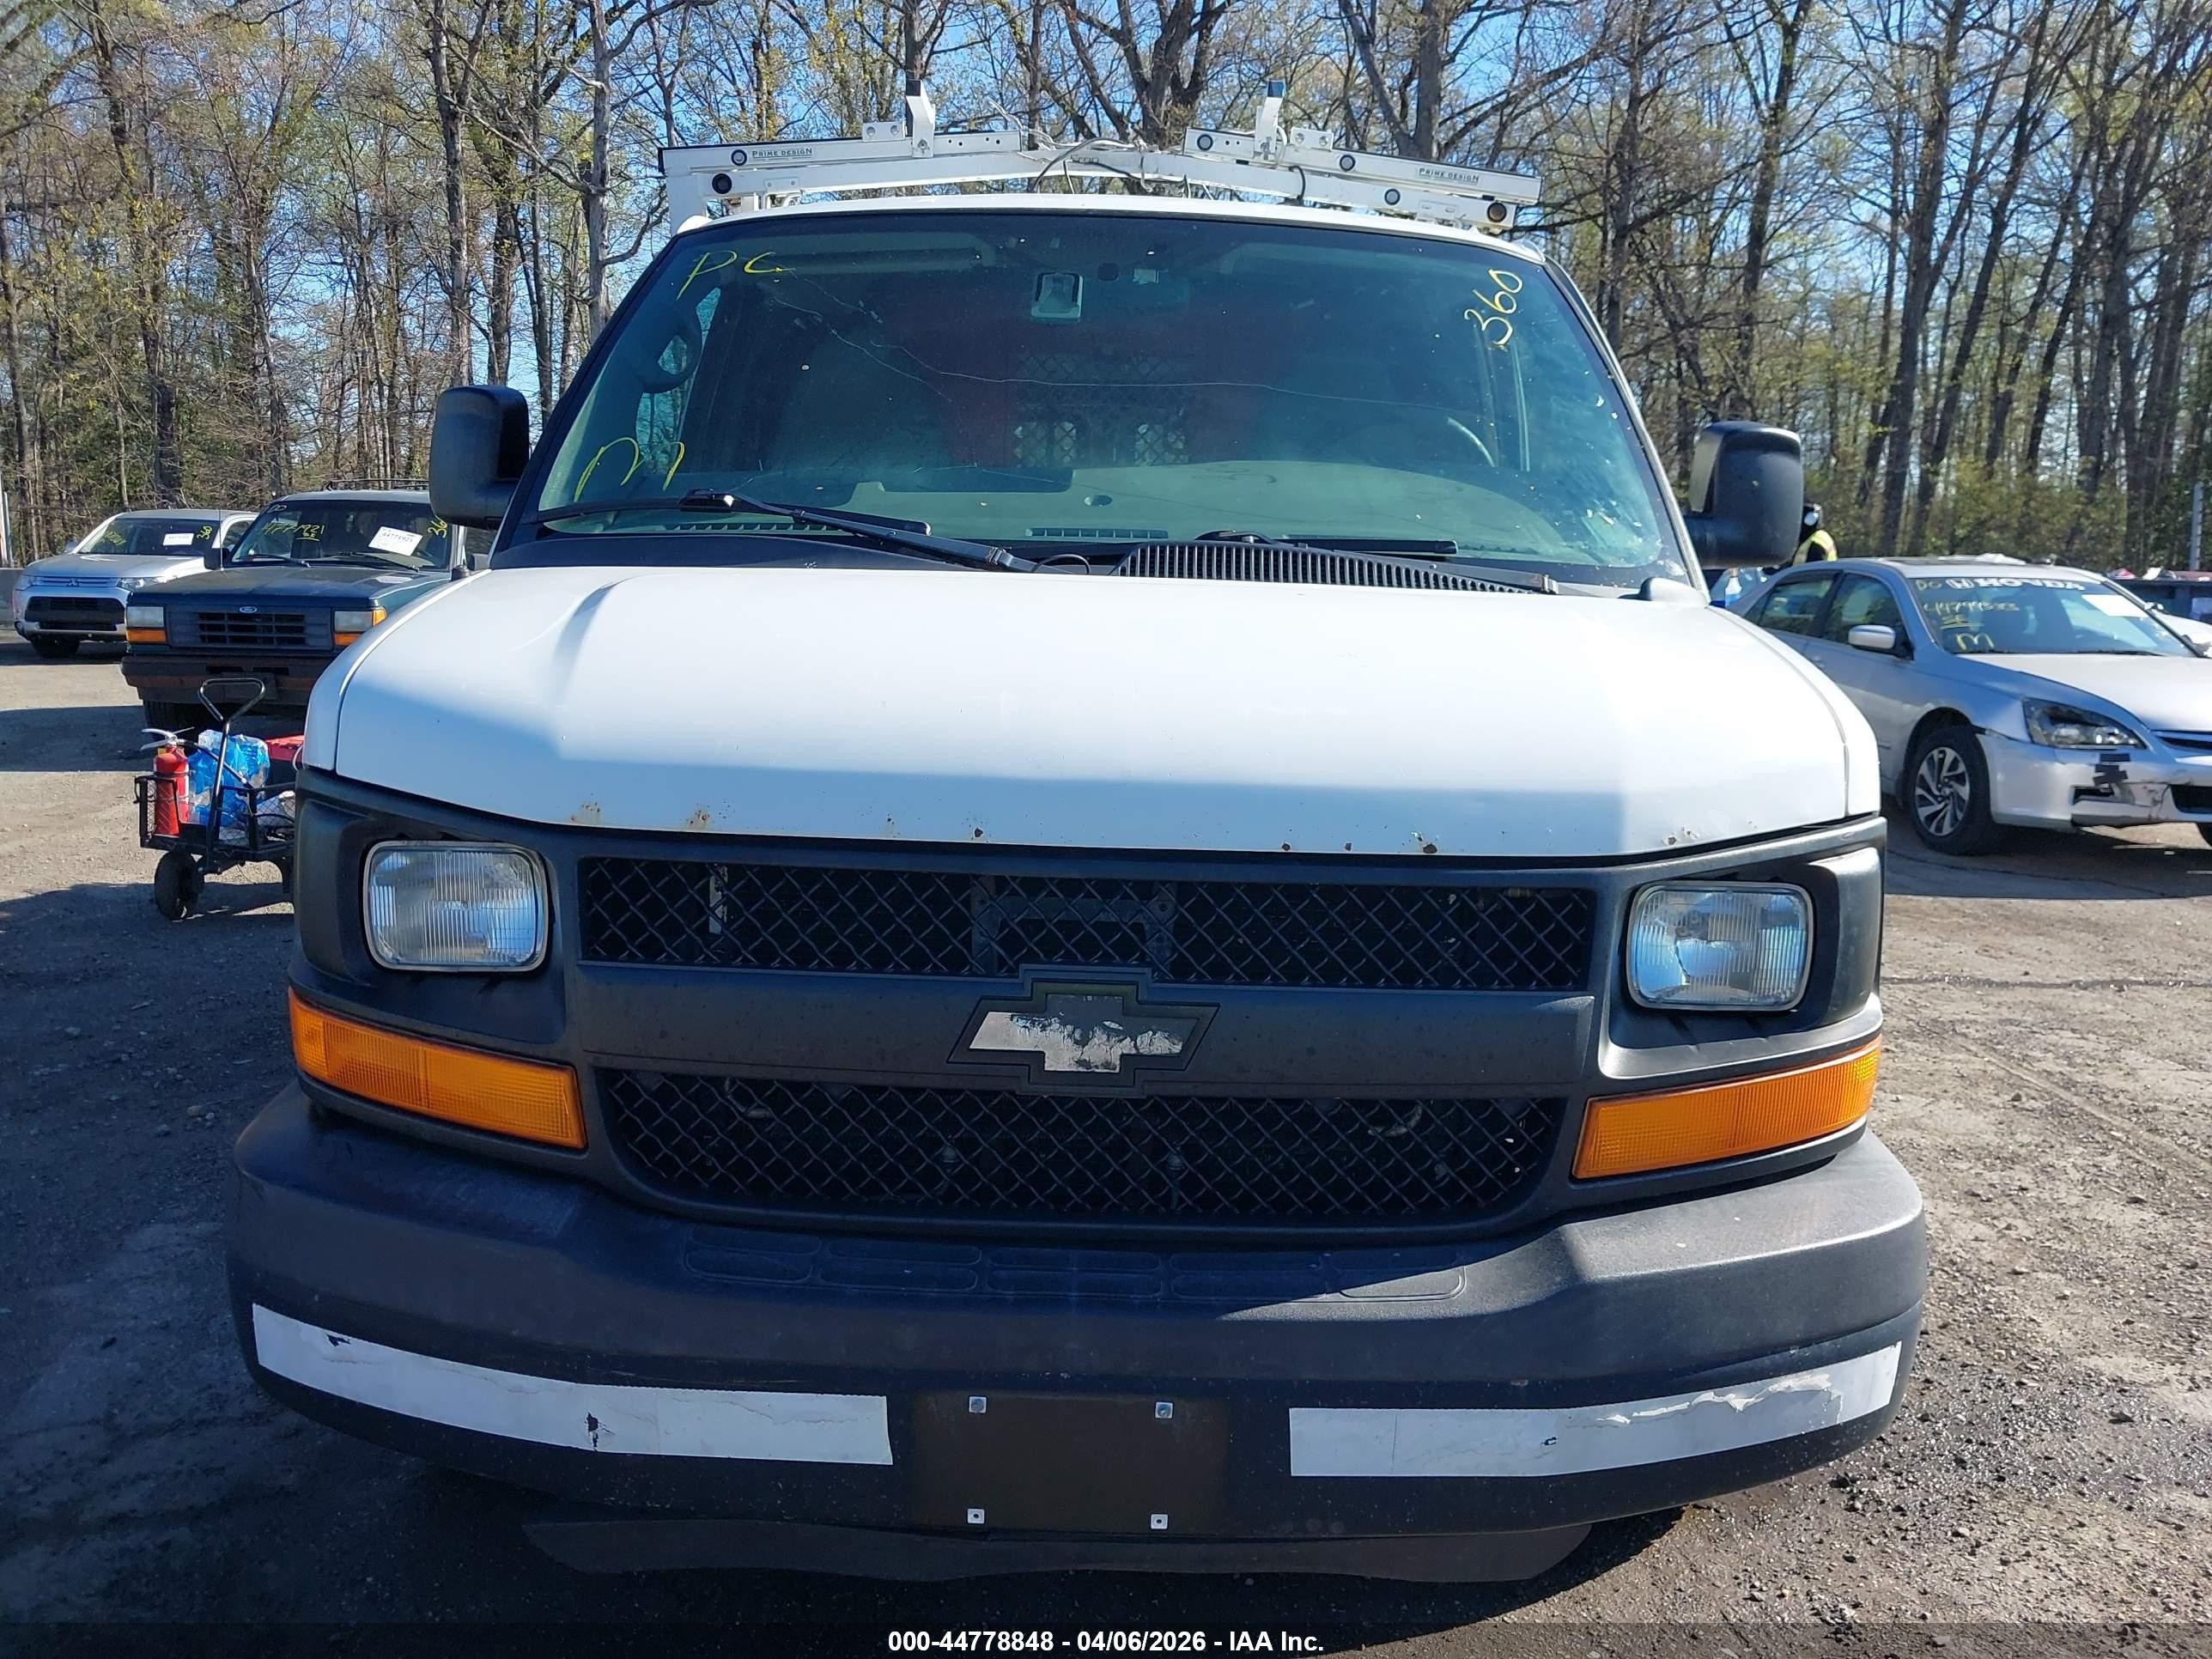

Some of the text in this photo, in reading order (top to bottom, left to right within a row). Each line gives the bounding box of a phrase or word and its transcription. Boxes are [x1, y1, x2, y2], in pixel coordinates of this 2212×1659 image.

[781, 147, 812, 156] DESIGN
[1463, 269, 1523, 347] 360
[428, 514, 448, 539] 36
